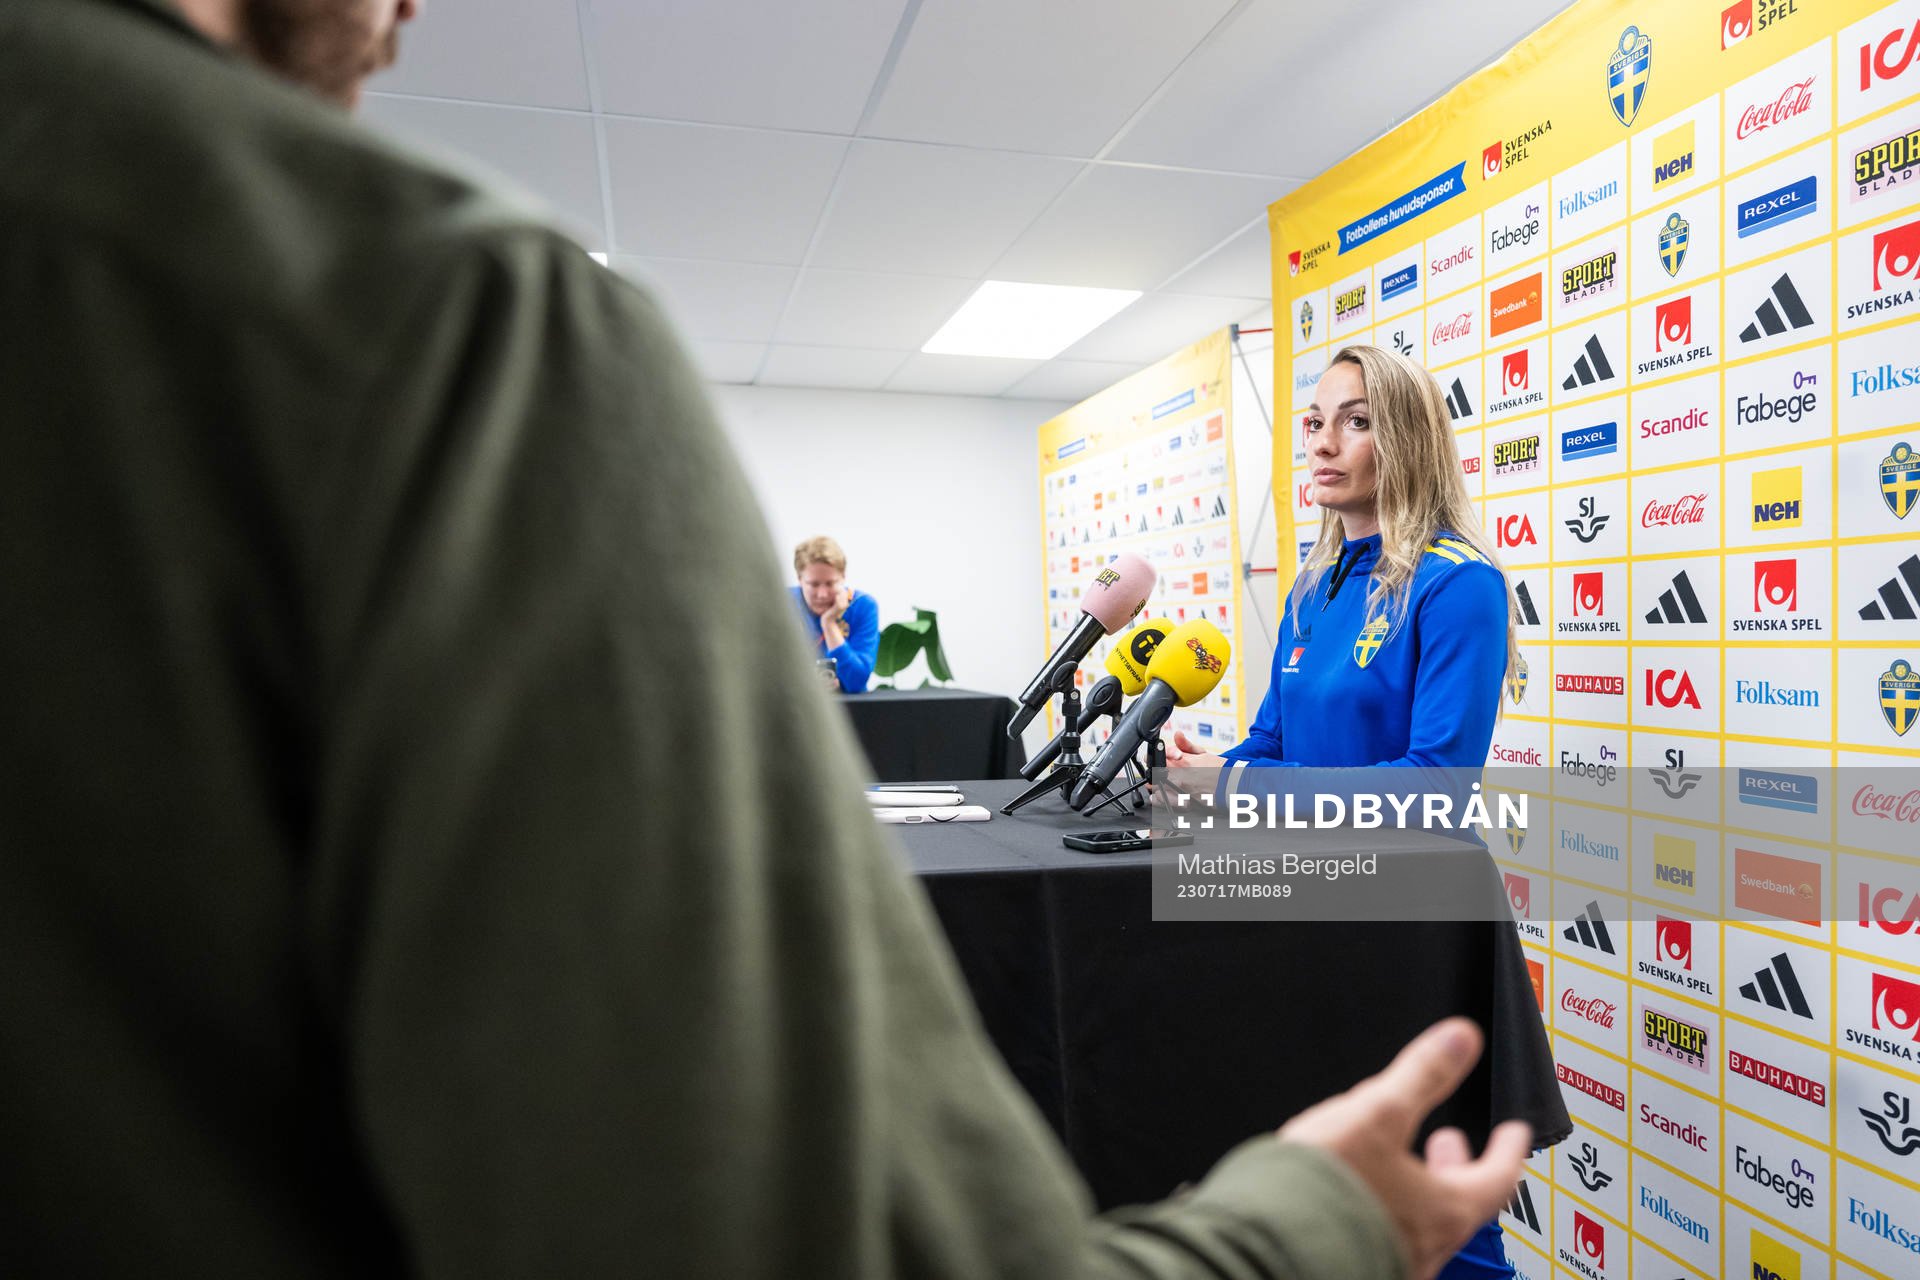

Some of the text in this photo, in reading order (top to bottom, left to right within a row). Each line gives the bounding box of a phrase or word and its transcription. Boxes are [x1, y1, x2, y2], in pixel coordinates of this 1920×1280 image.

[1758, 0, 1798, 31] SPEL
[1505, 119, 1552, 154] SVENSKA
[1505, 149, 1529, 169] SPEL
[1855, 129, 1920, 186] SPOR
[1859, 169, 1920, 196] BLAD
[1346, 178, 1454, 244] Fotbollens huvudsponsor
[1559, 180, 1618, 219] Folksam
[1302, 241, 1331, 262] SVENSKA
[1491, 219, 1539, 254] Fabege
[1302, 260, 1318, 273] SPEL
[1431, 245, 1474, 276] Scandic
[1562, 252, 1616, 295] SPORT
[1335, 285, 1366, 315] SPORT
[1565, 279, 1614, 303] BLADET
[1847, 290, 1914, 319] SVENSKA
[1493, 299, 1527, 318] Swedbank
[1638, 345, 1712, 375] SVENSKA SPEL
[1490, 391, 1543, 413] SVENSKA SPEL
[1737, 392, 1816, 425] Fabege
[1641, 407, 1709, 439] Scandic
[1493, 435, 1539, 467] SPORT
[1496, 460, 1538, 475] BLADET
[1579, 496, 1595, 518] SJ
[1497, 513, 1537, 548] ICA
[1558, 622, 1621, 632] SVENSKA SPEL
[1733, 618, 1822, 631] SVENSKA SPEL
[1556, 675, 1623, 694] BAUHAUS
[1645, 669, 1702, 710] ICA
[1735, 679, 1820, 707] Folksam
[1493, 744, 1542, 766] Scandic
[1561, 751, 1616, 786] Fabege
[1665, 749, 1684, 772] SJ
[1852, 784, 1920, 823] Coca-Co
[1560, 829, 1619, 861] Folksam
[1740, 873, 1796, 896] Swedbank
[1526, 923, 1545, 939] SPEL
[1638, 961, 1712, 996] SVENSKA SPEL
[1644, 1009, 1707, 1059] SPORT
[1846, 1028, 1912, 1061] SVENSKA
[1647, 1038, 1705, 1068] BLADET
[1557, 1064, 1624, 1109] BAUHAUS
[1730, 1053, 1824, 1103] BAUHAUS
[1883, 1091, 1910, 1124] SJ
[1640, 1104, 1708, 1152] Scandic
[1581, 1142, 1598, 1168] SJ
[1736, 1145, 1814, 1208] Fabege
[1640, 1186, 1709, 1244] Folksam
[1848, 1196, 1920, 1252] Folksa
[1559, 1248, 1598, 1280] SVENSKA
